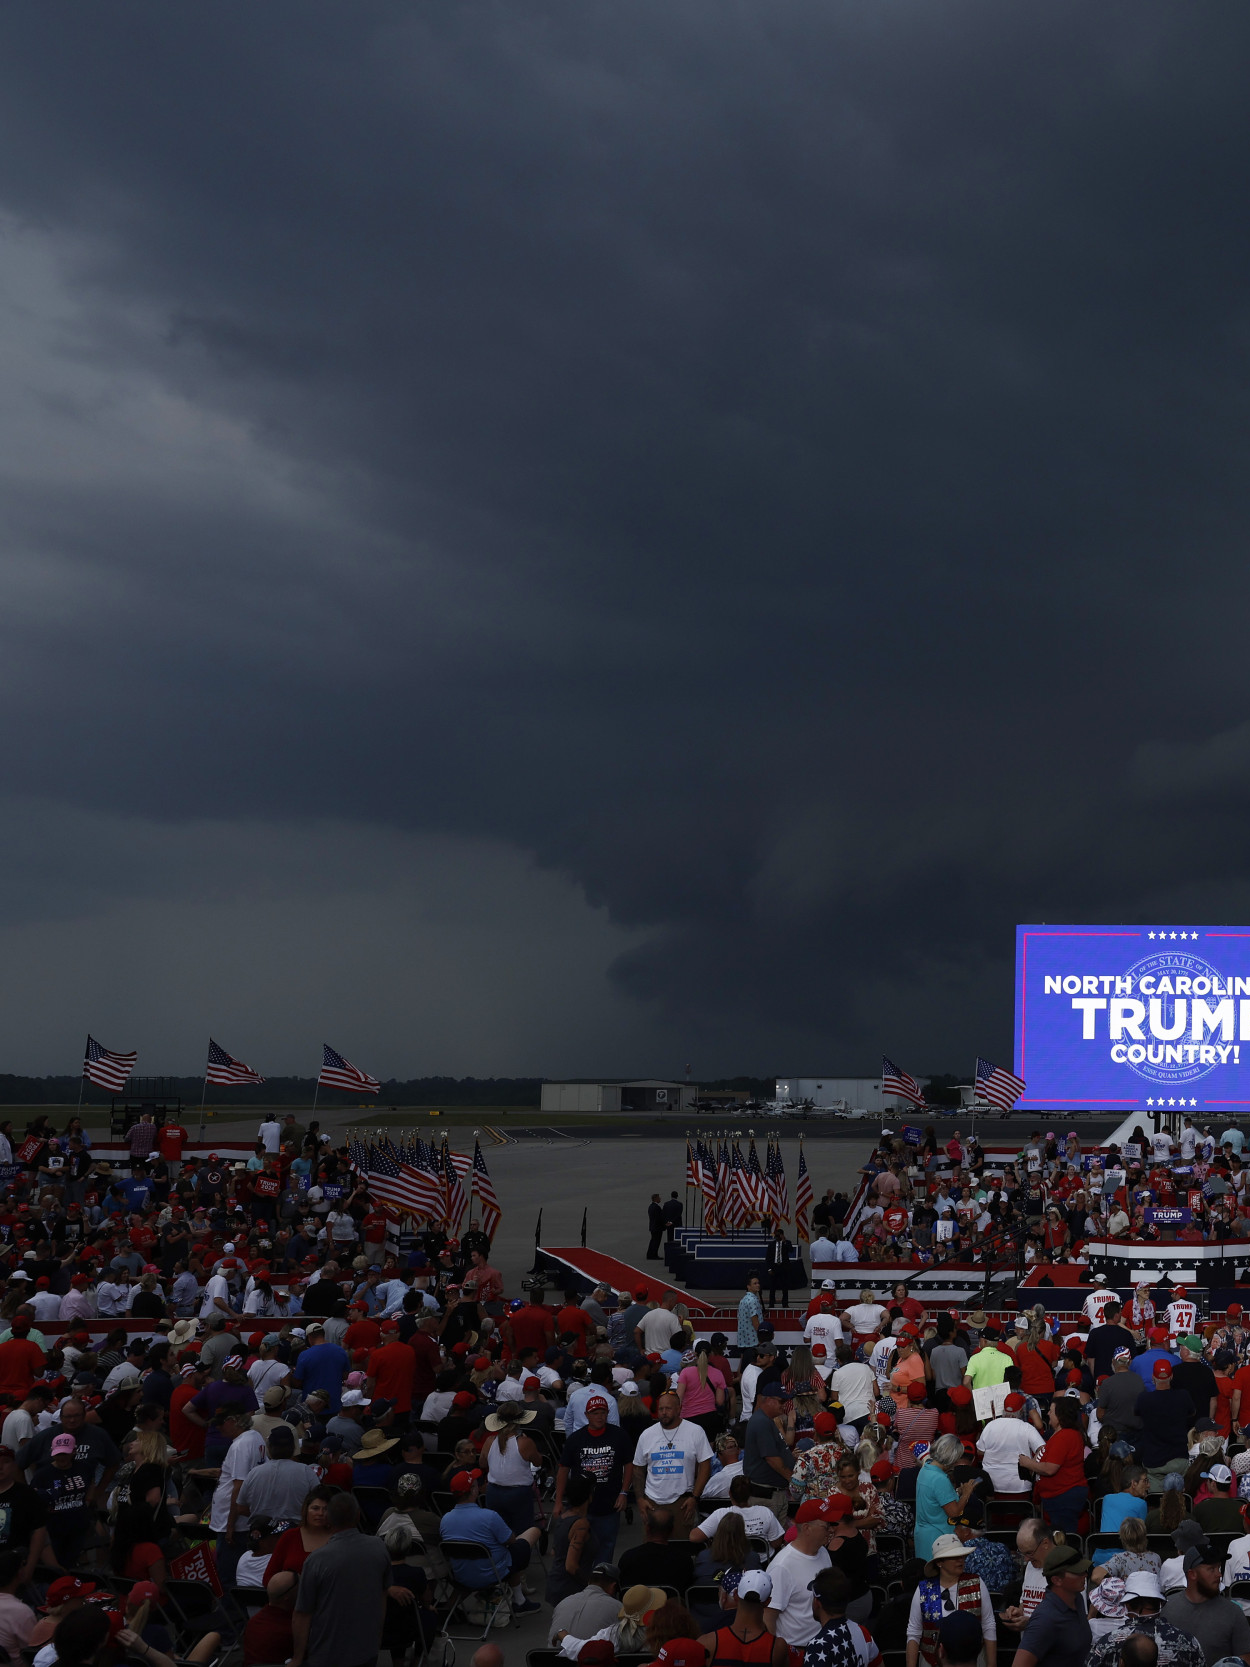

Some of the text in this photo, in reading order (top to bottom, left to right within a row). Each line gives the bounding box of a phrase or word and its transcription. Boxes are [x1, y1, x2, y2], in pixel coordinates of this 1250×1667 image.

[1159, 956, 1195, 969] STATE
[1044, 975, 1131, 994] NORTH
[1110, 1044, 1240, 1064] COUNTRY!
[1142, 1066, 1158, 1076] ESSE
[1178, 1066, 1200, 1078] VIDERI
[1094, 1295, 1116, 1303] TRUMP
[1176, 1312, 1192, 1328] 47
[583, 1446, 611, 1454] TRUMP
[54, 1500, 83, 1511] BRANDON
